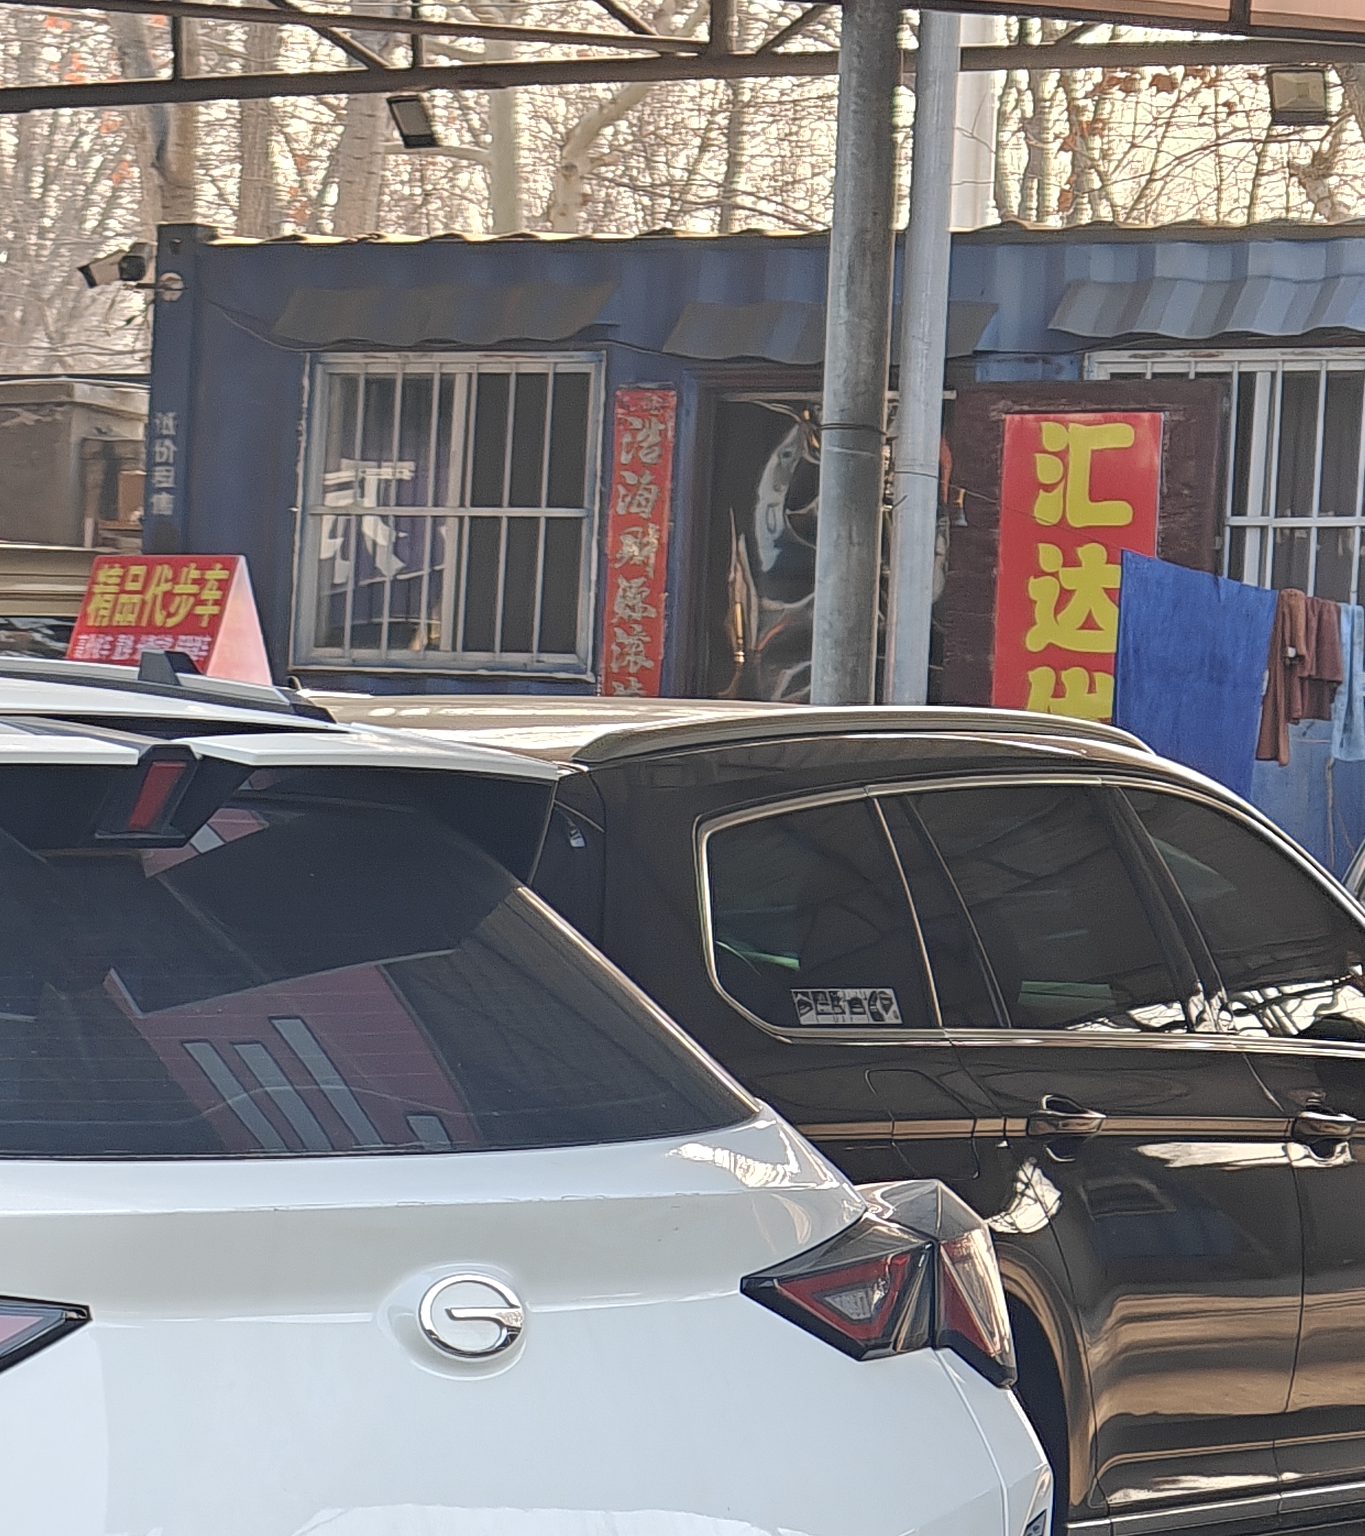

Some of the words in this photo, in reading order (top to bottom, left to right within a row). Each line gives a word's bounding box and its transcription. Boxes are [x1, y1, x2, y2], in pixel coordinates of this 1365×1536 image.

[86, 562, 230, 628] 精品代步车
